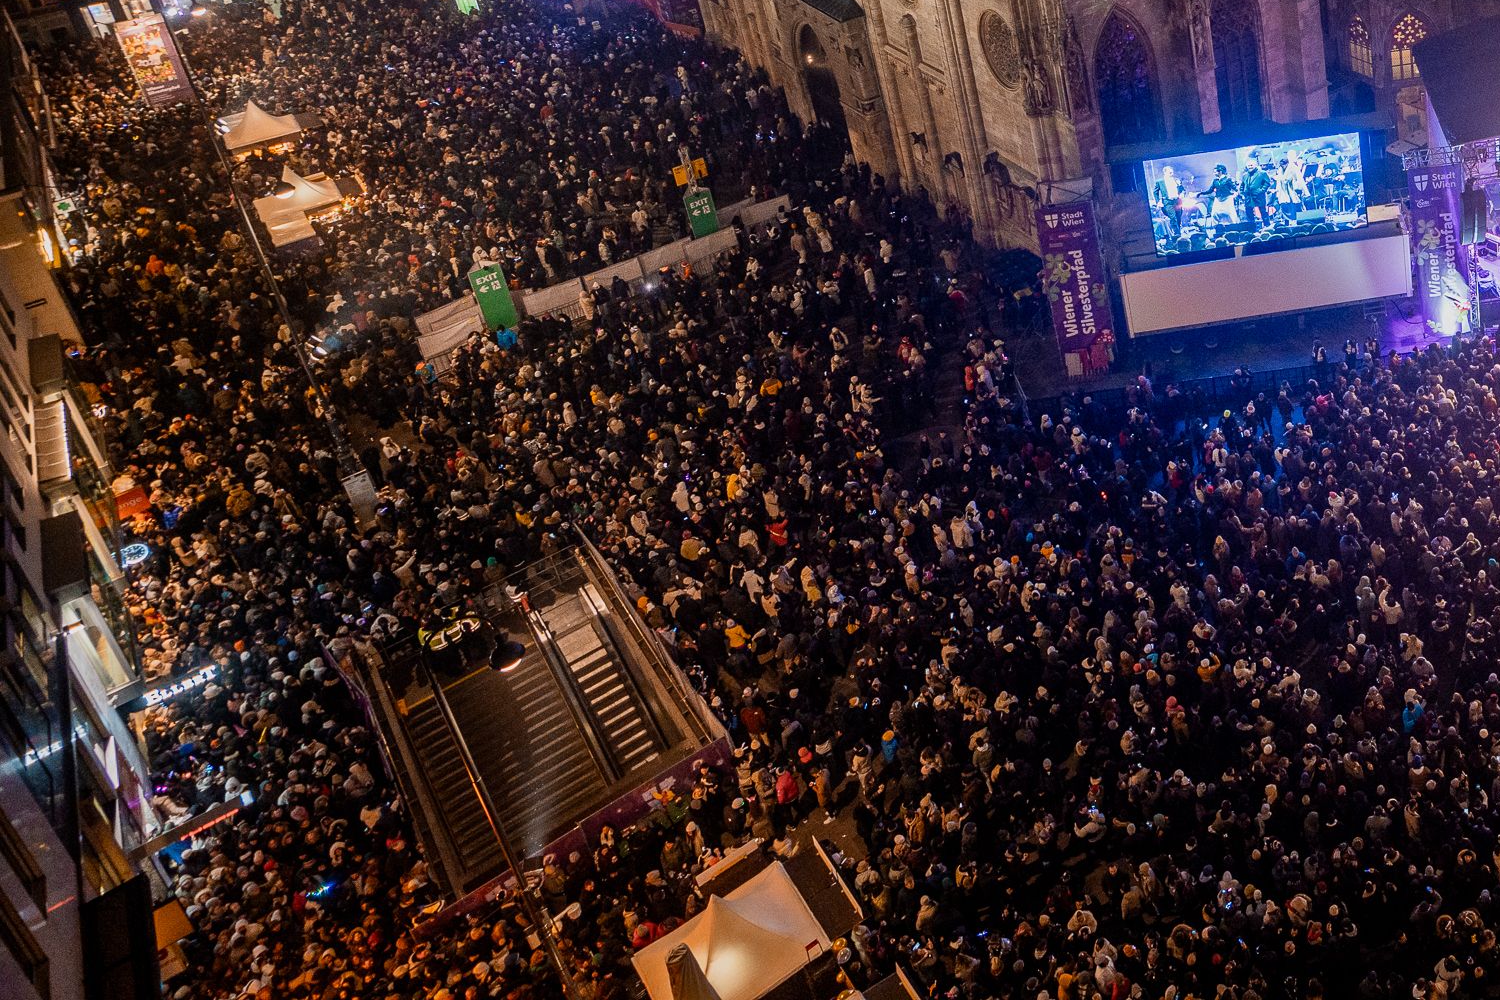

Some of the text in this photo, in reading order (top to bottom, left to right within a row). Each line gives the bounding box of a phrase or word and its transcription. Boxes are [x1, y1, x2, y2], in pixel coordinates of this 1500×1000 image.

[1432, 172, 1456, 181] Stadt
[1432, 180, 1457, 189] Wien
[689, 197, 709, 209] EXIT
[1061, 210, 1084, 220] Stadt
[1062, 218, 1085, 227] Wien
[476, 272, 498, 286] EXIT
[1429, 252, 1441, 298] Wiener
[1068, 250, 1096, 335] Silvesterpfad
[1062, 289, 1079, 338] Wiener
